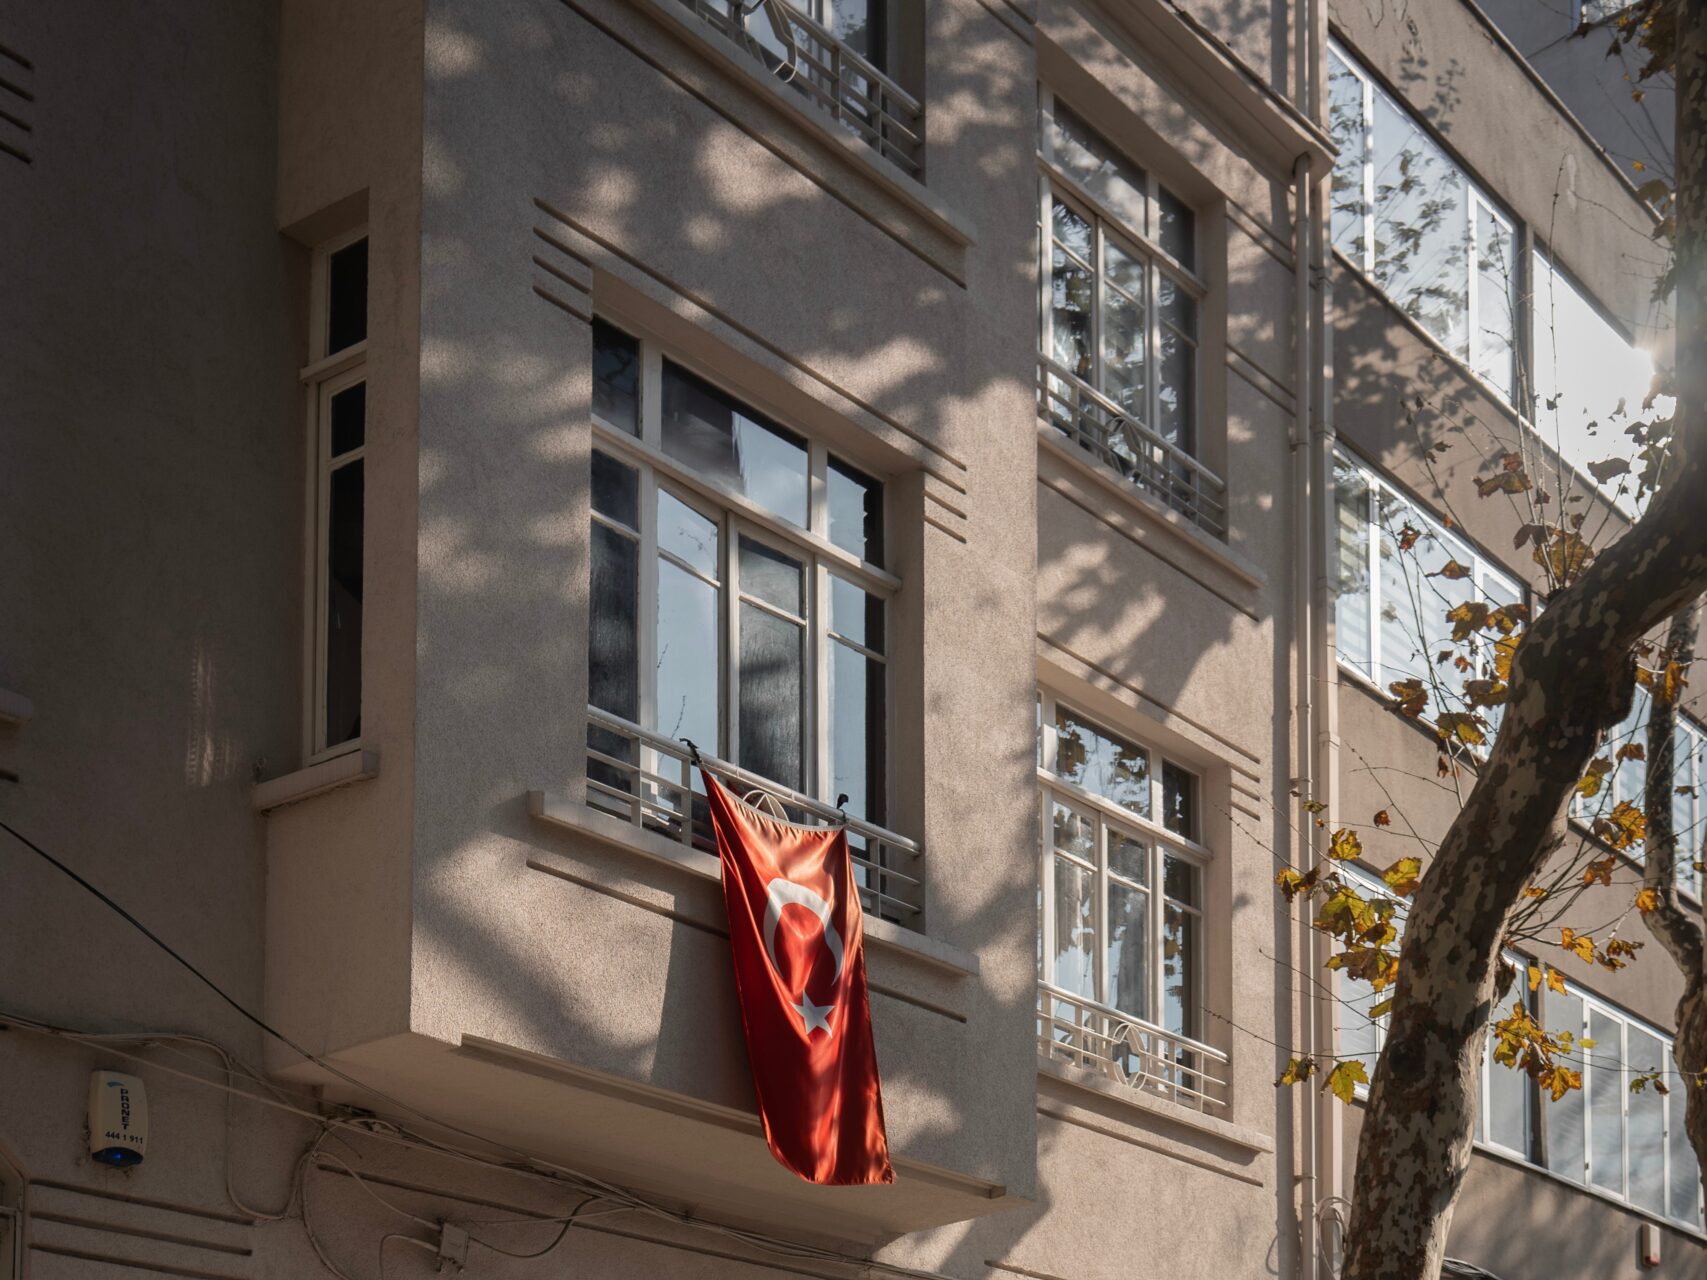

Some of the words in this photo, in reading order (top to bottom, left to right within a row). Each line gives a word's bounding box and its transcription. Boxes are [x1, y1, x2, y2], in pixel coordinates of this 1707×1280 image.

[120, 1088, 130, 1130] PRONET
[105, 1131, 120, 1140] 444
[129, 1135, 144, 1144] 911
